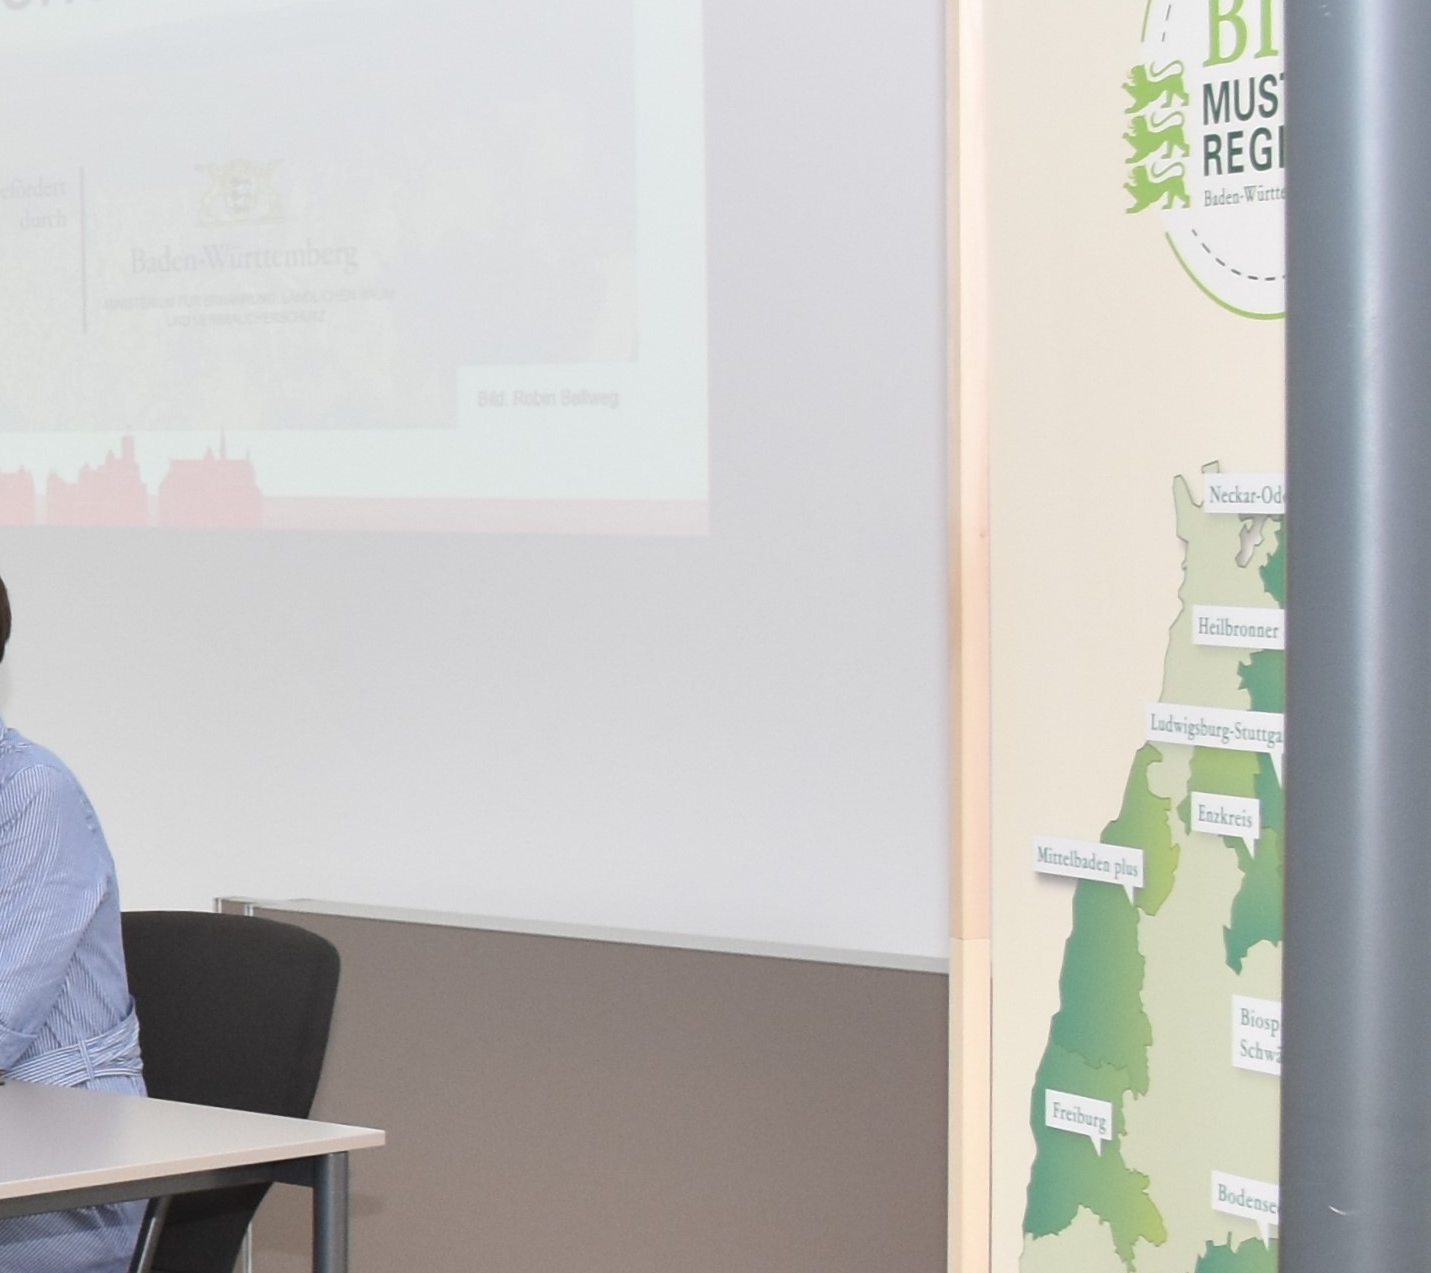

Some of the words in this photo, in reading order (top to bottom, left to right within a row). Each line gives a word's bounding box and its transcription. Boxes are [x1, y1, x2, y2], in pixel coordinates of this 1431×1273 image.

[1203, 73, 1285, 126] MUS
[129, 237, 360, 276] Baden-Württemberg
[1197, 616, 1279, 640] Heilbronner
[1197, 803, 1253, 829] Enzkreis
[1036, 845, 1110, 873] Mittelbaden
[1114, 857, 1139, 880] plus
[1051, 1101, 1107, 1135] Freiburg
[1218, 1183, 1279, 1215] Bodense
